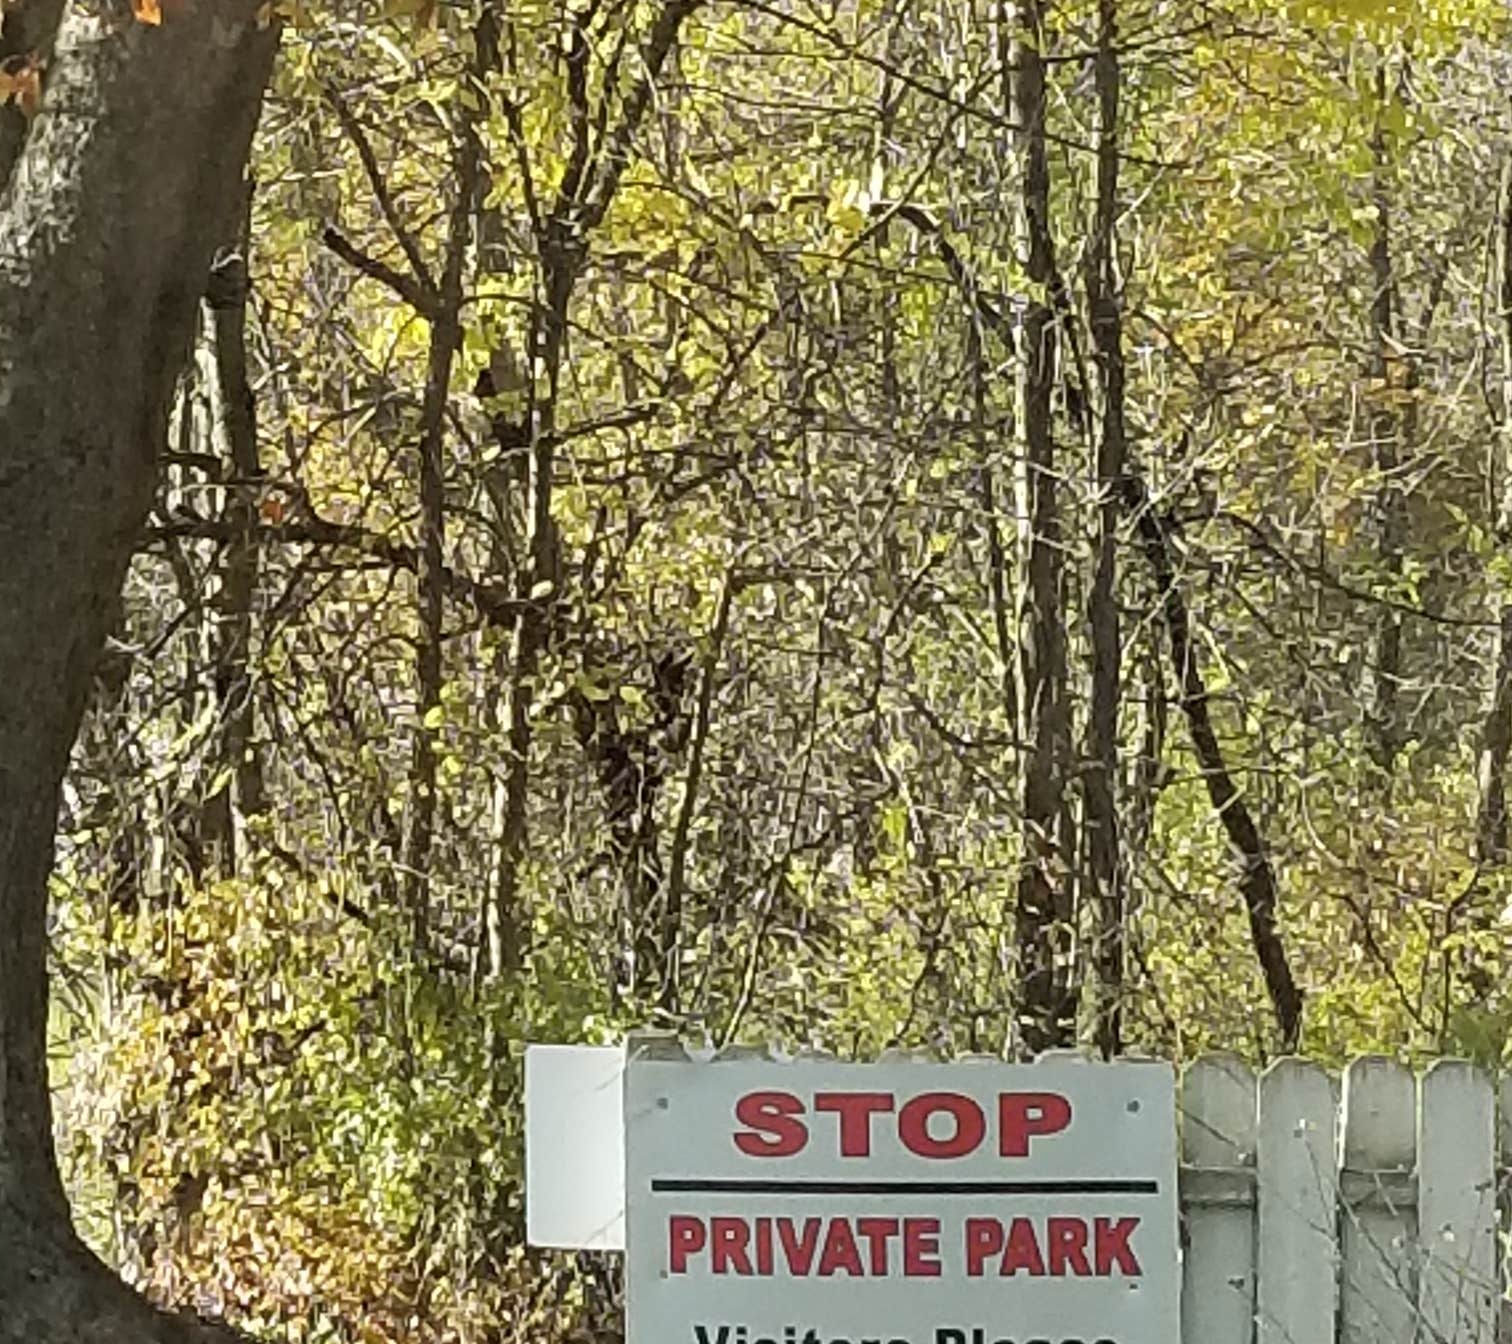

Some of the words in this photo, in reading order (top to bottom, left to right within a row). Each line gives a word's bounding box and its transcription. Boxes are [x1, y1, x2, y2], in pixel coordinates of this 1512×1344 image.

[732, 1091, 1073, 1160] STOP
[669, 1215, 942, 1277] PRIVATE
[965, 1217, 1143, 1277] PARK
